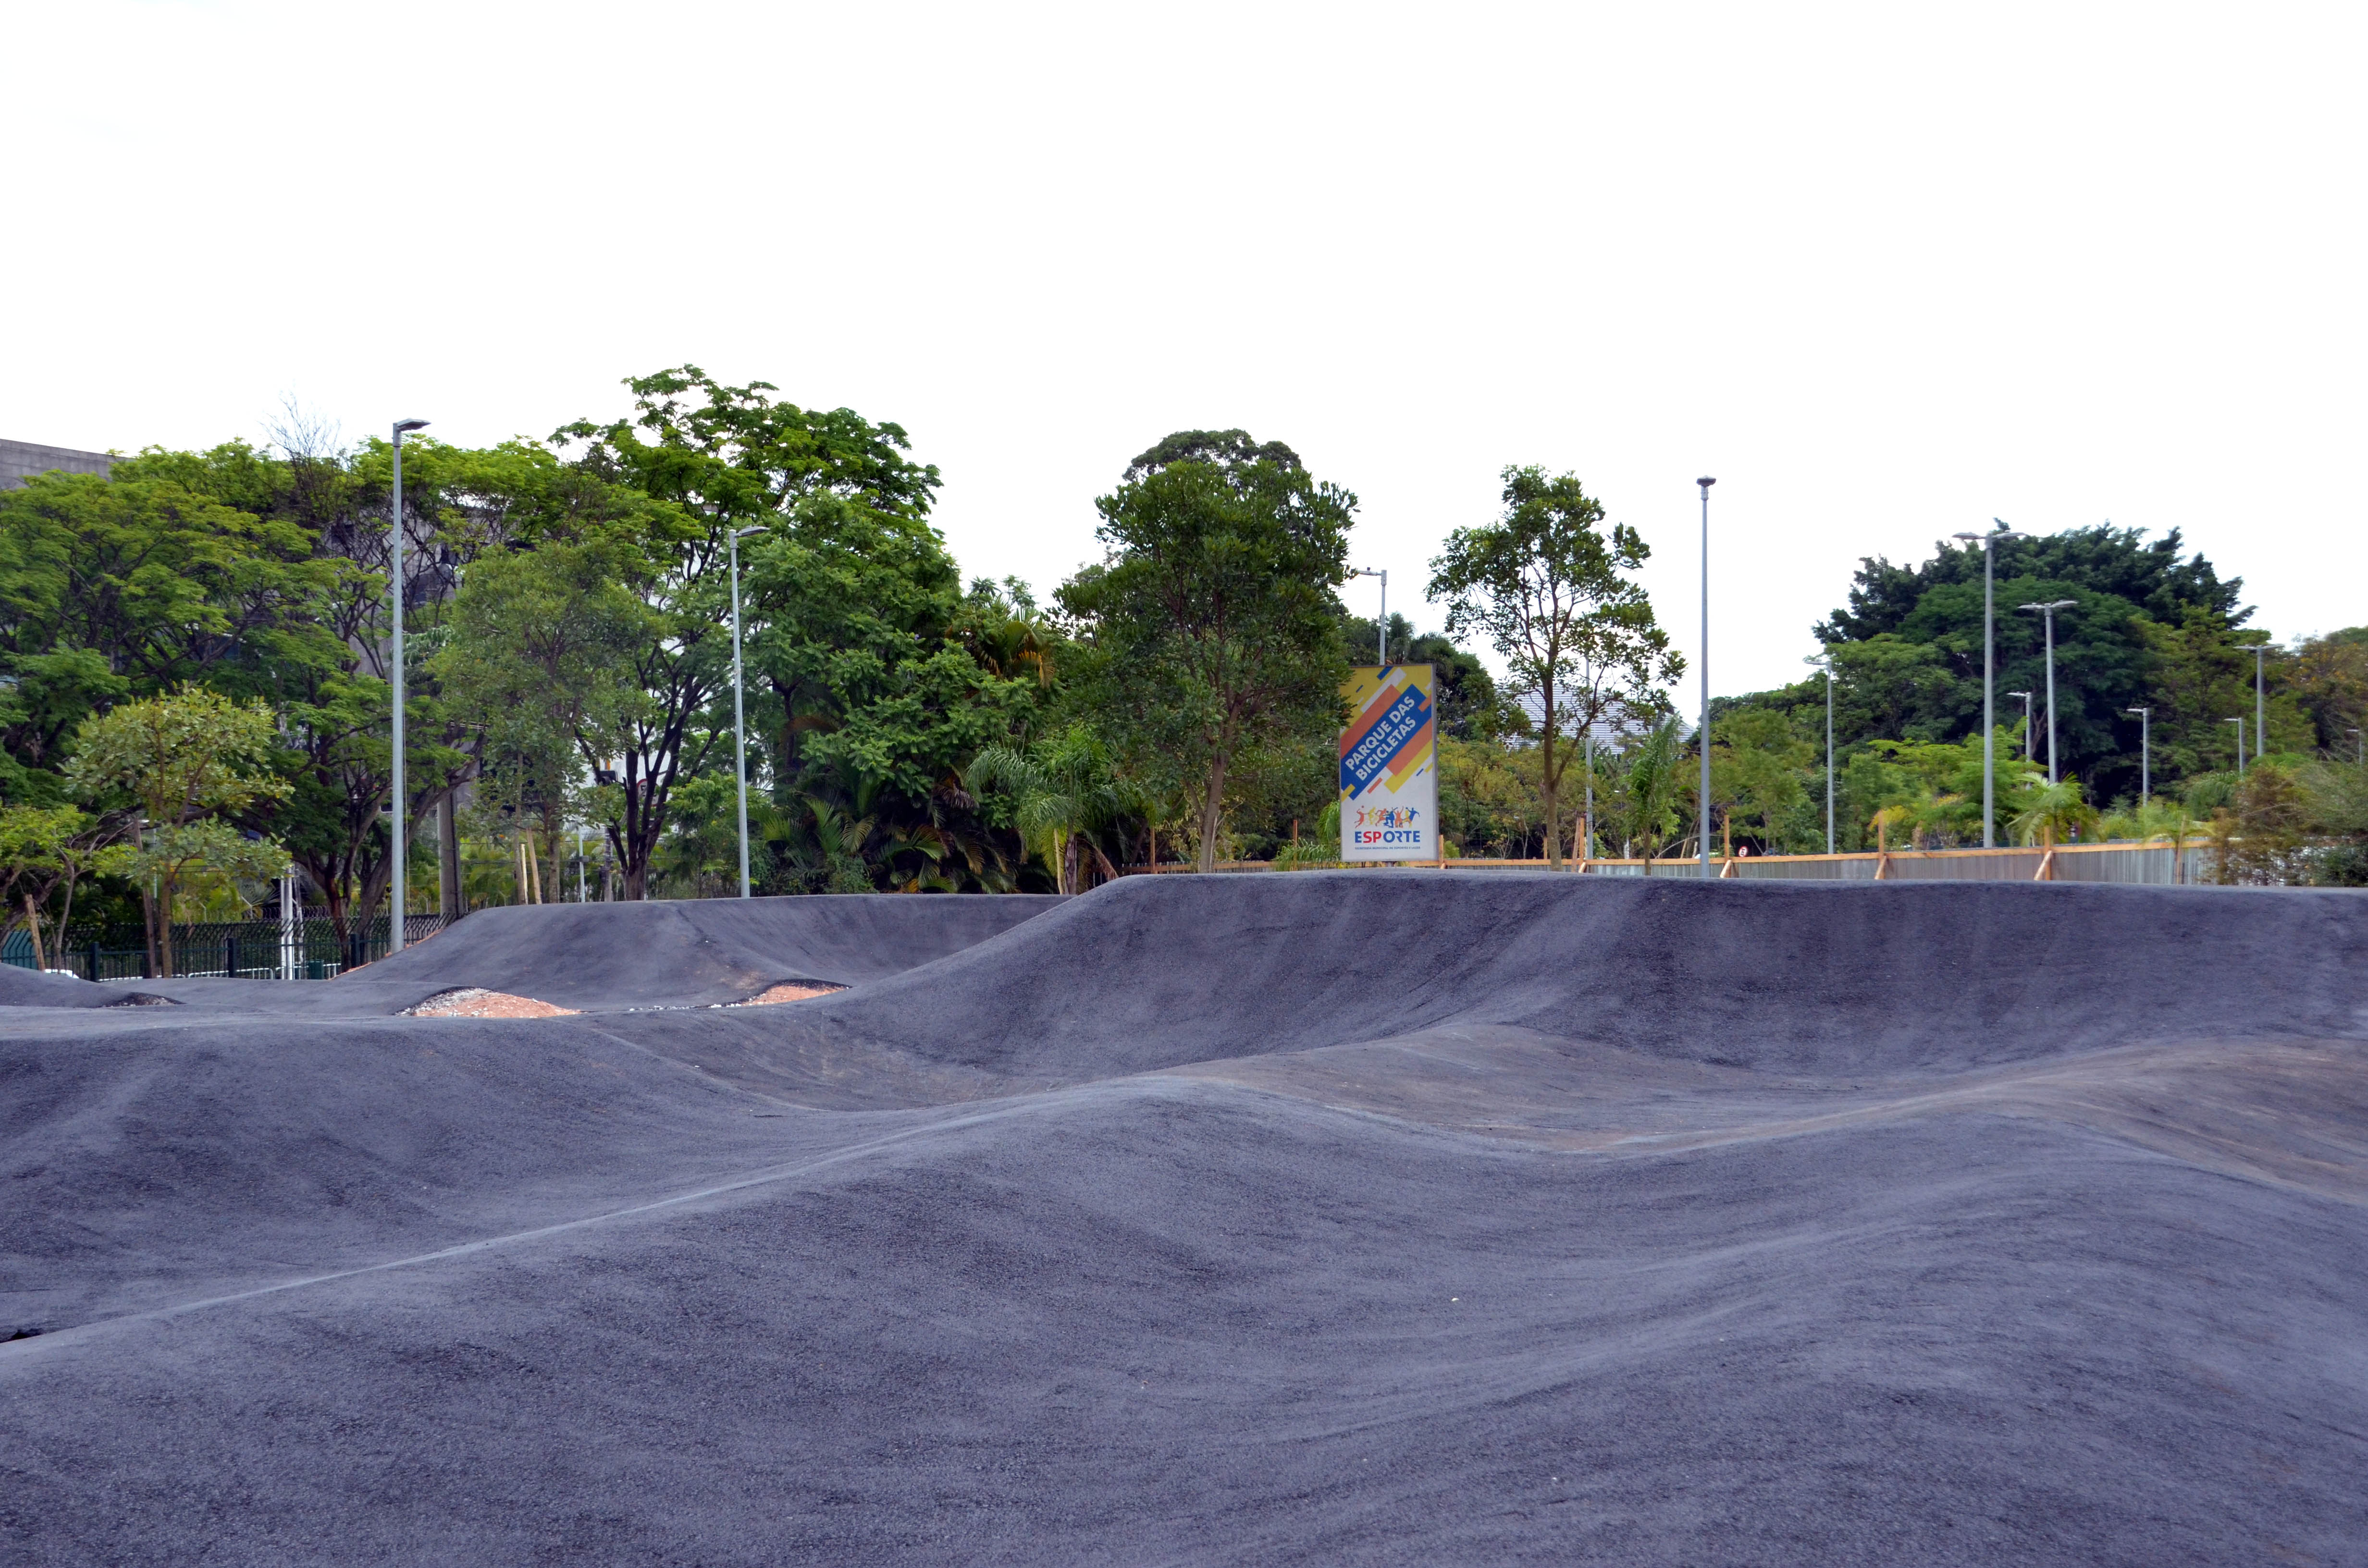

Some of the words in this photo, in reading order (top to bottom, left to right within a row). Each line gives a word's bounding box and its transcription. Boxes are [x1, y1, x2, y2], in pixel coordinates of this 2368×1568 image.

[1345, 721, 1392, 770] PARQUE
[1389, 696, 1415, 723] DAS
[1356, 716, 1416, 781] BICICLETAS
[1355, 831, 1420, 843] ESPORTE
